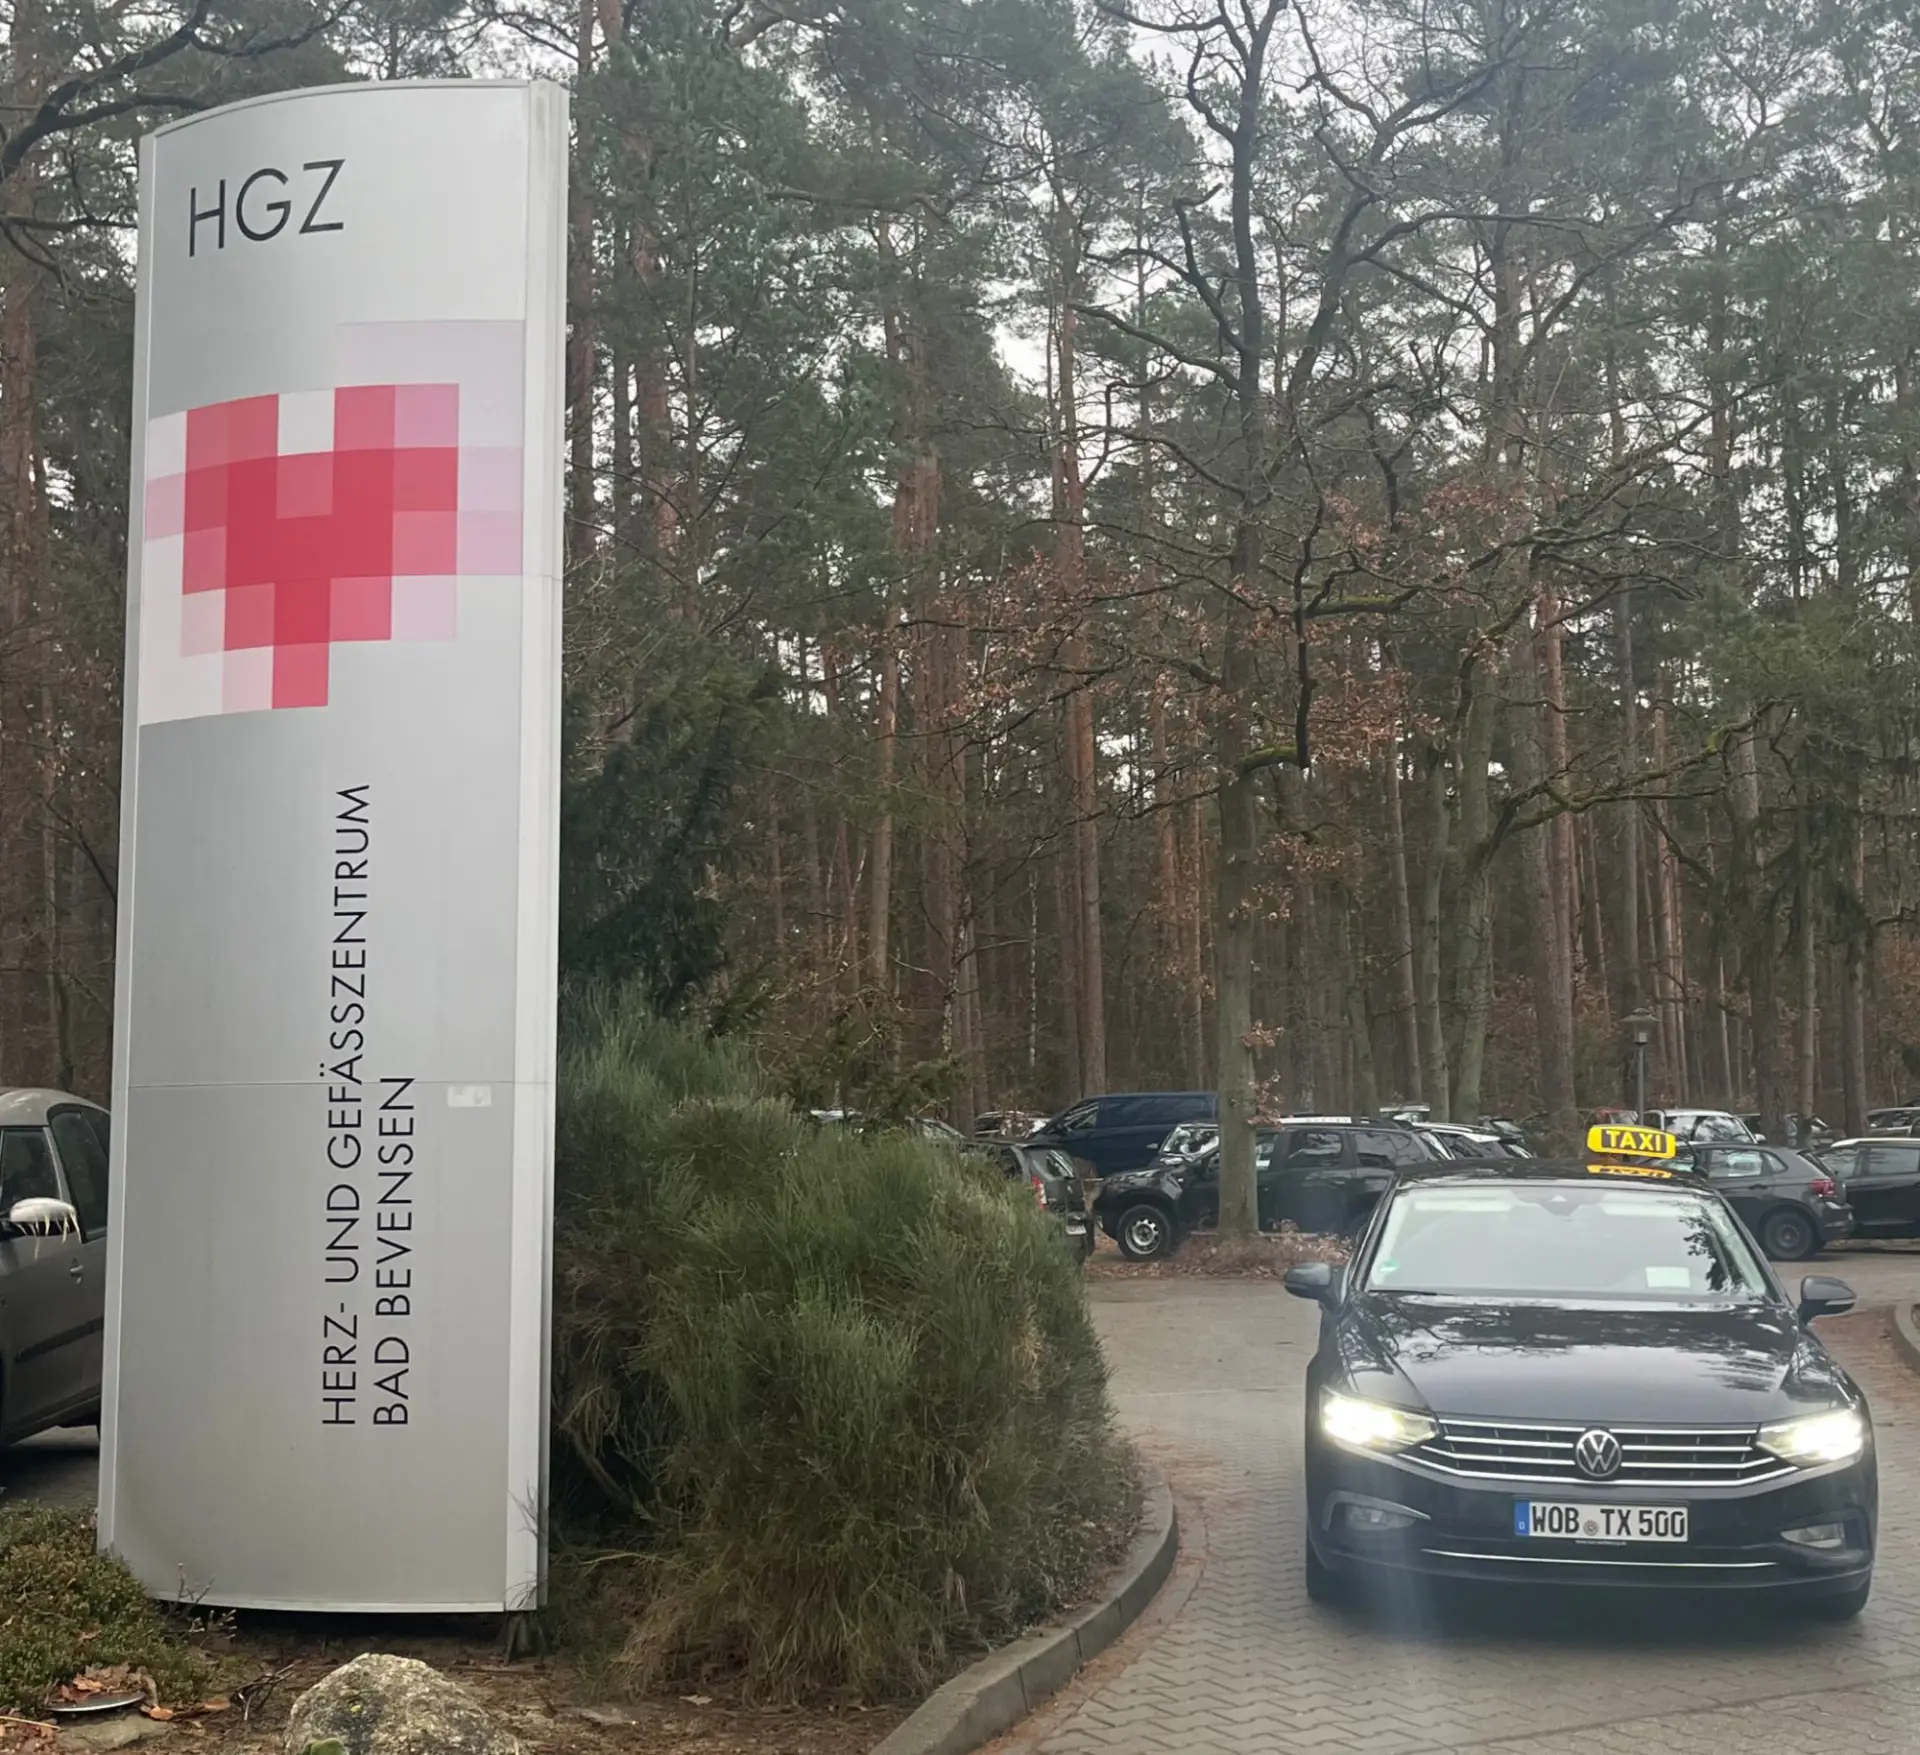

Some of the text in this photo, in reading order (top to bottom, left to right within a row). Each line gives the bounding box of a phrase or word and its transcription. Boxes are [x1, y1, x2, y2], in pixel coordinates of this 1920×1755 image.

[189, 159, 345, 257] HGZ
[319, 785, 370, 1425] HERZ- UND GEFÄSSZENTRUM
[1605, 1130, 1662, 1152] TAXI
[373, 1077, 415, 1425] BAD BEVENSEN
[1532, 1505, 1580, 1534] WOB
[1600, 1508, 1632, 1536] TX
[1638, 1510, 1686, 1538] 500
